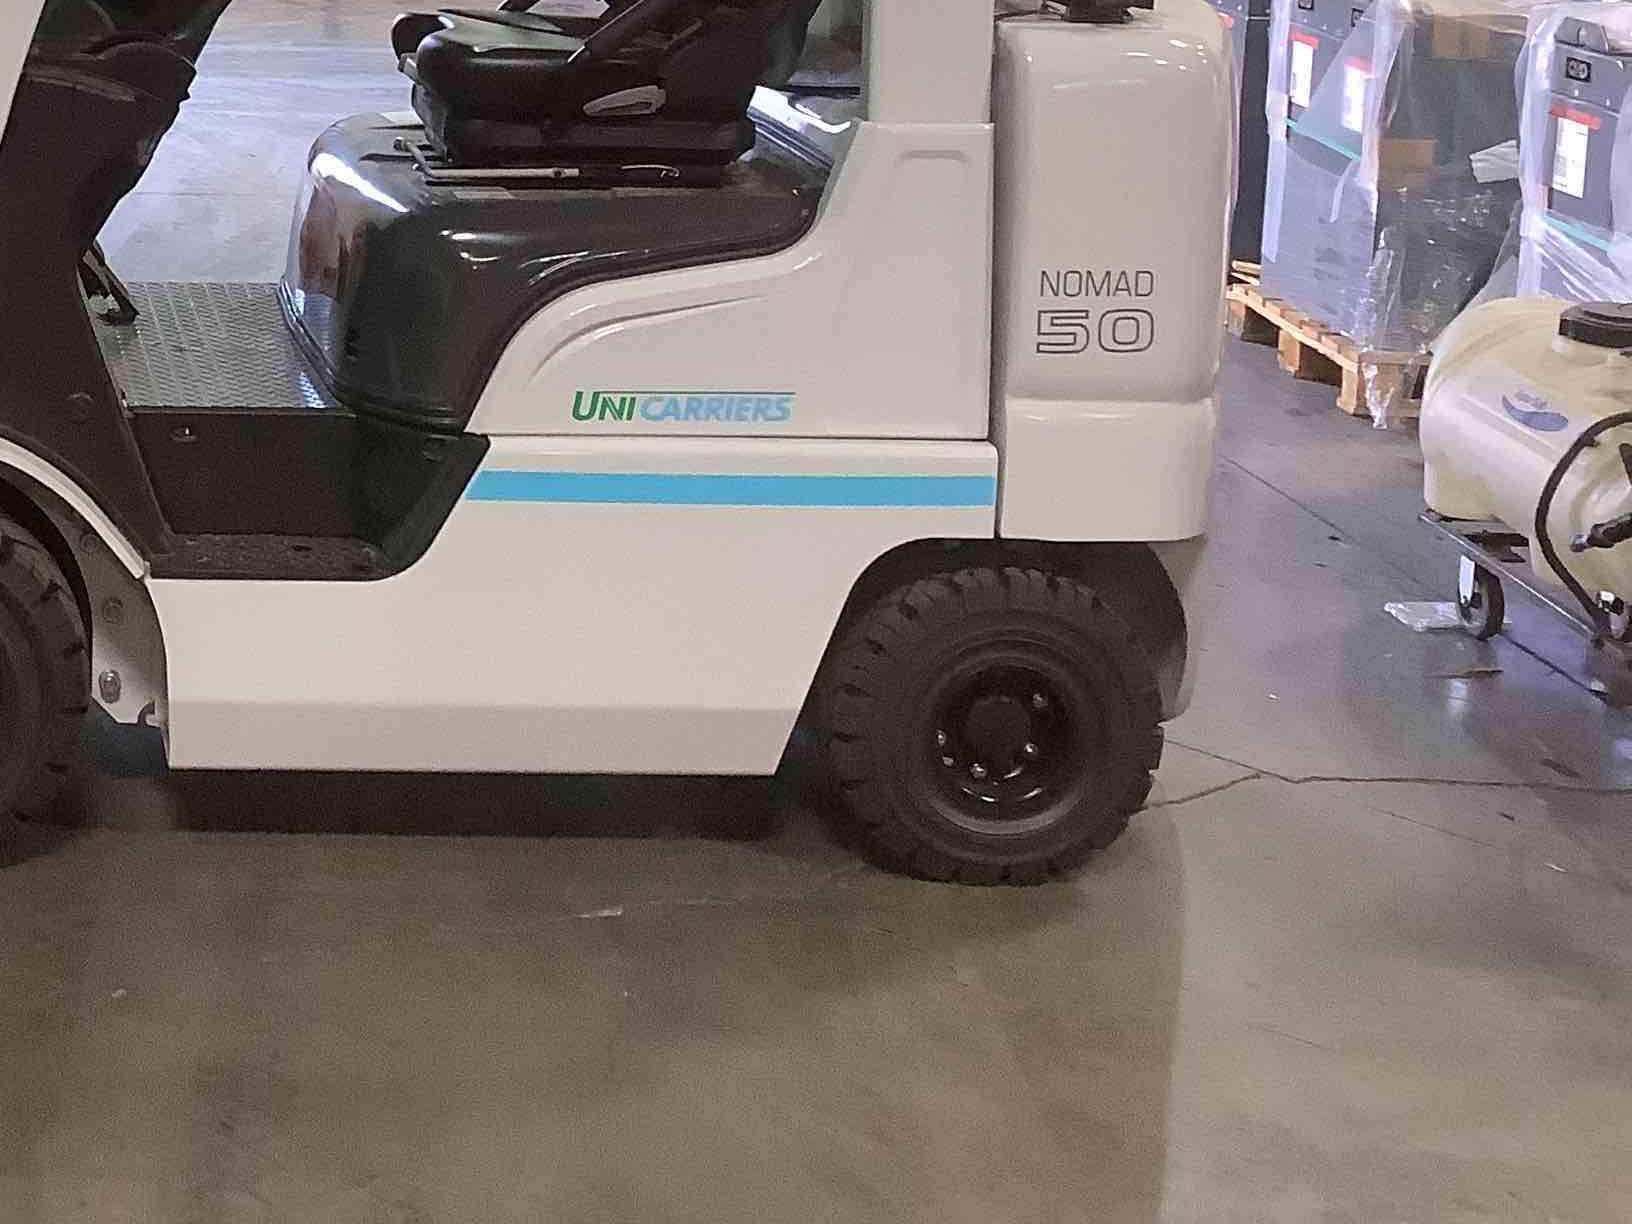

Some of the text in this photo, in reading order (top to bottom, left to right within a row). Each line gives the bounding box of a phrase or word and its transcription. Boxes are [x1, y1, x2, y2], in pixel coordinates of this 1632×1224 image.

[1040, 270, 1154, 297] NOMAD
[1036, 308, 1155, 354] 50
[571, 390, 792, 423] UNICARRIERS
